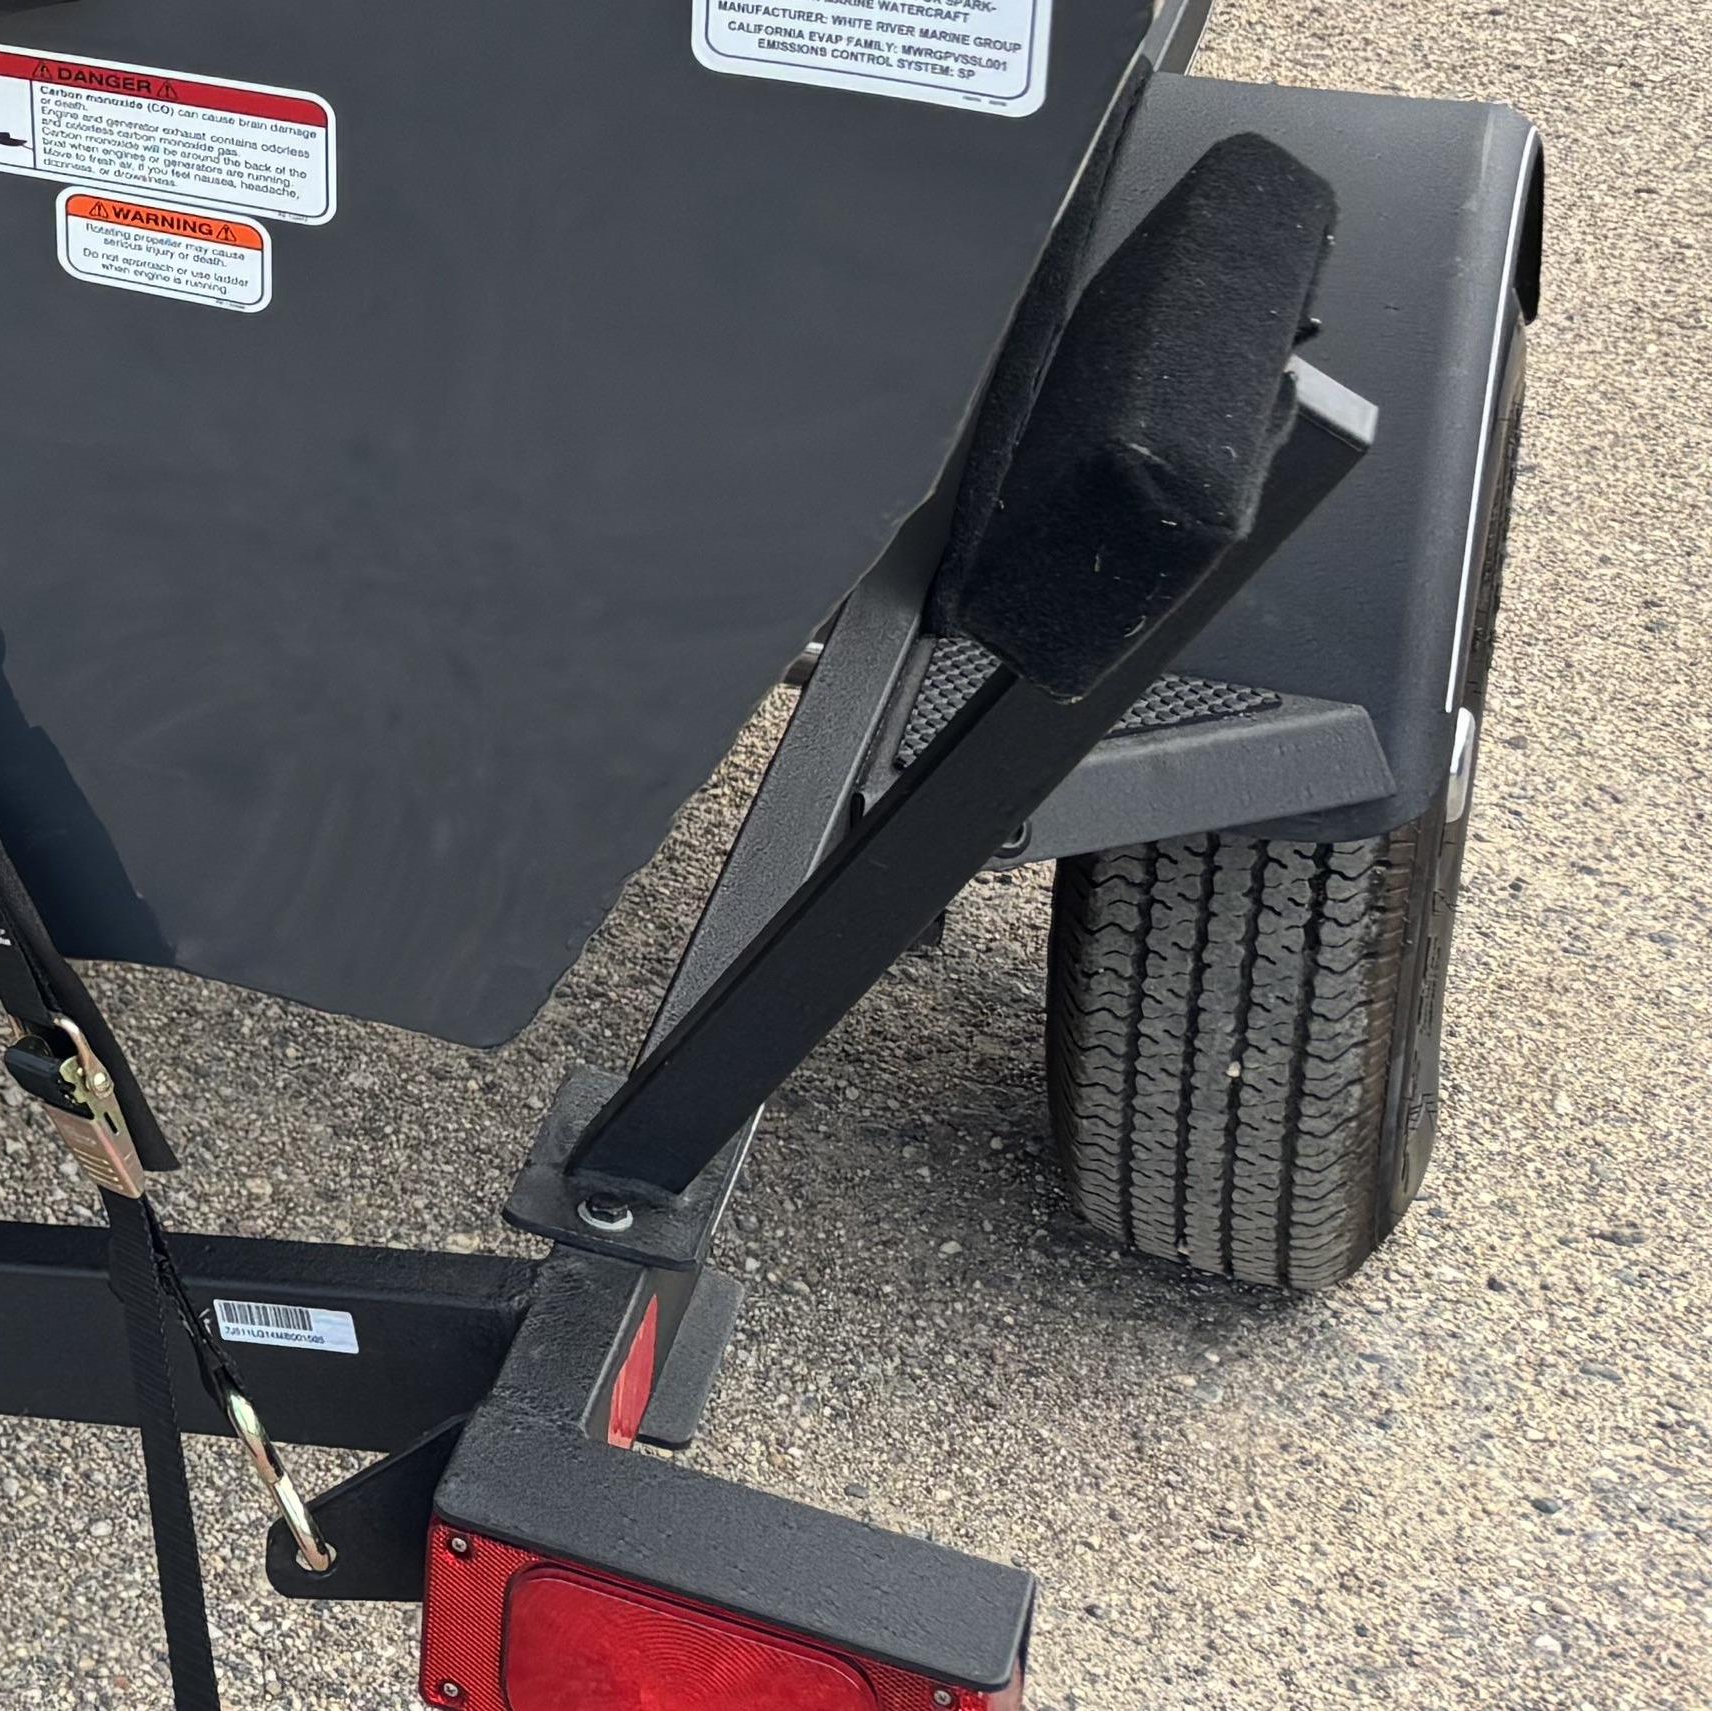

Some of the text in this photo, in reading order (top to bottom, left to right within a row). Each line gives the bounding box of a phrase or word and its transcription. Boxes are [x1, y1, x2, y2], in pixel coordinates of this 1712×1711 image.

[718, 0, 1022, 54] MANUFACTURER: WHITE RIVER MARINE GROUP
[877, 0, 971, 24] WATERCRAFT
[728, 20, 805, 40] CALIFORNIA
[808, 31, 843, 45] EVAP
[846, 37, 898, 54] FAMILY:
[758, 38, 976, 80] EMISSIONS CONTROL SYSTEM: SP
[58, 67, 151, 94] DANGER
[40, 97, 88, 112] or death.
[40, 86, 317, 140] Carbon monoxide (CO) can cause brain damage
[41, 106, 310, 159] Engine and generator exhaust contains odorless
[41, 117, 61, 128] and
[65, 122, 115, 136] colorless
[117, 130, 157, 143] carbon
[159, 137, 214, 153] monoxide
[42, 126, 307, 180] Carbon monoxide will be around the back of the
[70, 143, 99, 154] when
[102, 148, 146, 163] engines
[149, 154, 160, 164] or
[163, 158, 223, 175] generators
[227, 169, 245, 179] are
[43, 148, 72, 159] Move
[75, 152, 86, 162] to
[89, 155, 116, 167] fresh
[147, 166, 169, 177] you
[171, 169, 191, 180] feel
[194, 173, 237, 189] nausea,
[240, 180, 300, 200] headache,
[99, 168, 110, 176] or
[112, 205, 213, 237] WARNING
[86, 223, 245, 261] Rotating propeller may cause
[103, 238, 143, 252] serious
[145, 245, 176, 260] injury
[178, 251, 190, 260] or
[83, 247, 249, 288] Do not approach or use ladder
[101, 263, 182, 285] when engine is
